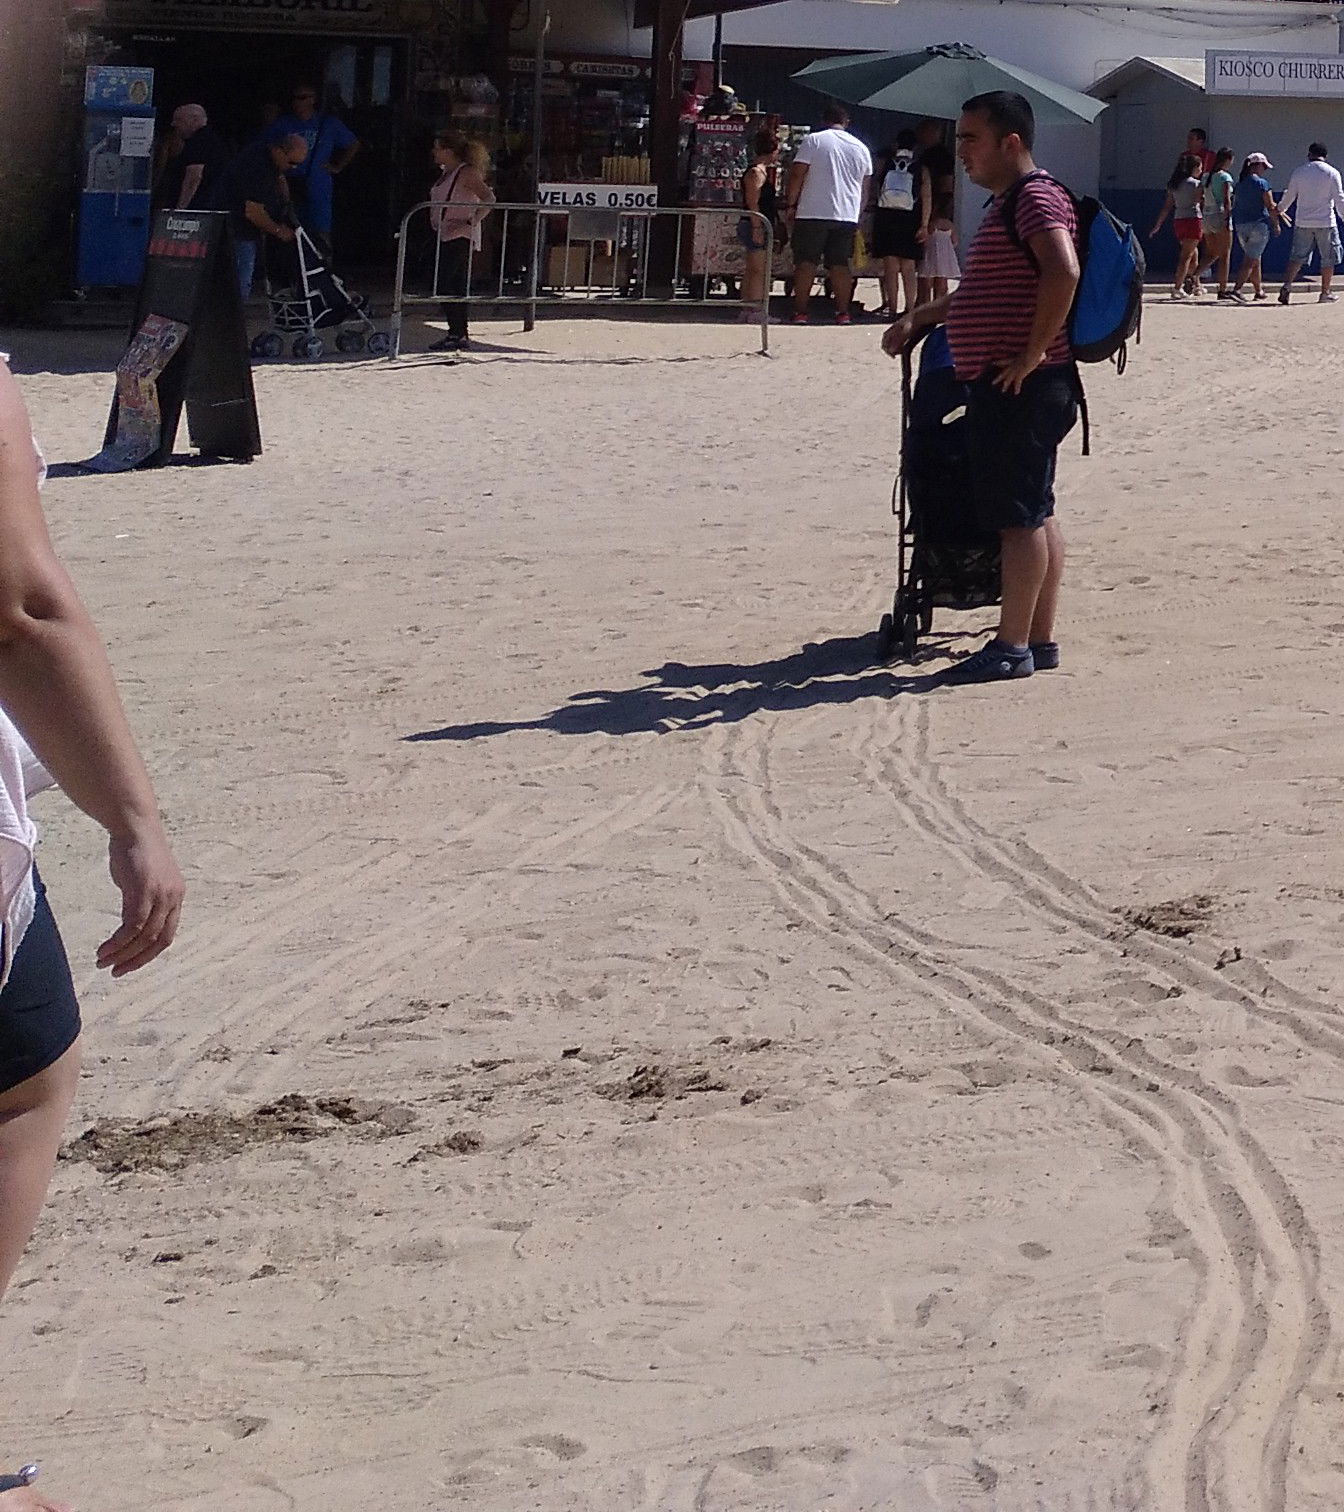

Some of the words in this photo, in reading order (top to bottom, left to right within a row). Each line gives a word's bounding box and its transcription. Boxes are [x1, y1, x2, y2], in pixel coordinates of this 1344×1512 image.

[1218, 59, 1275, 78] KIOSCO
[537, 191, 597, 206] VELAS
[607, 192, 657, 208] 0.50€
